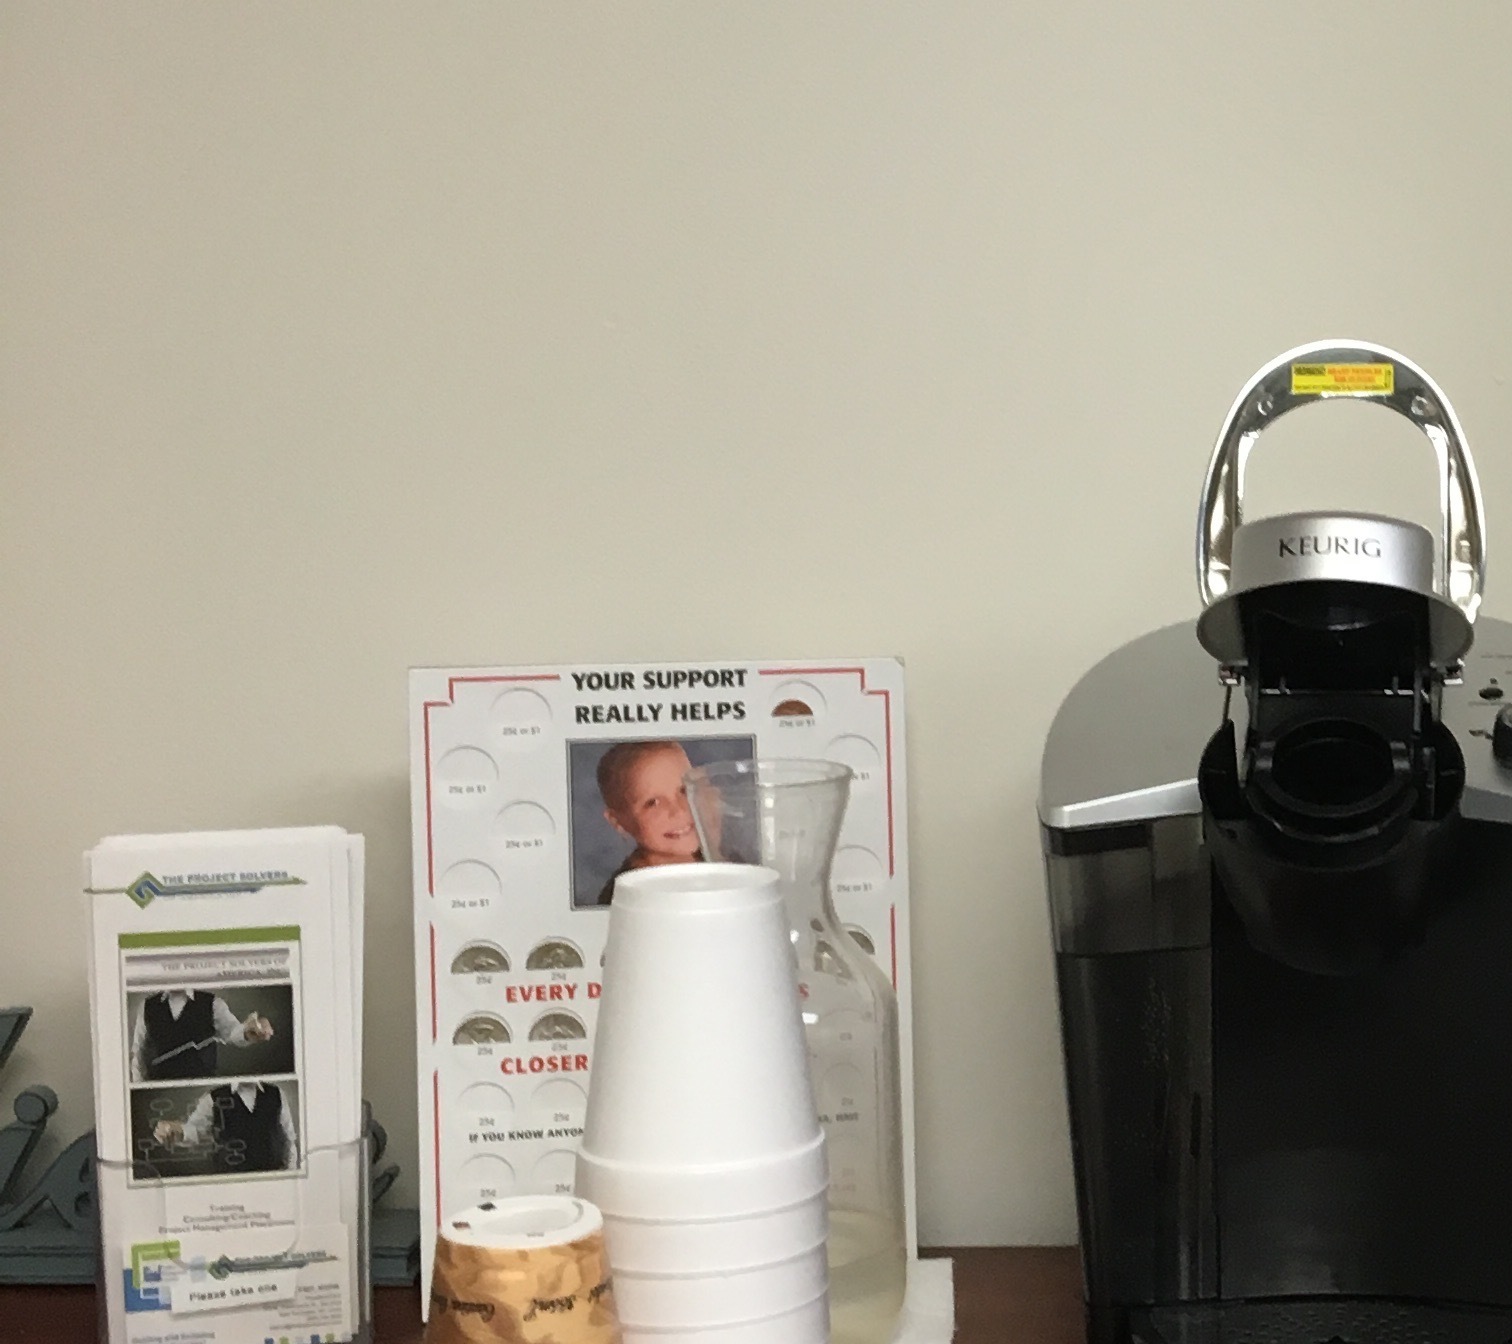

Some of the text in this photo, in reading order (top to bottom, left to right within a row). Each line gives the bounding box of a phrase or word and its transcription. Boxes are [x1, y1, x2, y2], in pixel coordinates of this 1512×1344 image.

[1279, 535, 1382, 558] KEURIG
[571, 669, 748, 691] YOUR SUPPORT
[575, 701, 746, 724] REALLY HELPS
[187, 871, 237, 884] PROJECT
[505, 982, 578, 1004] EVERY
[500, 1053, 589, 1075] CLOSER
[481, 1131, 505, 1143] YOU
[508, 1128, 544, 1141] KNOW
[189, 1283, 278, 1302] Please take one
